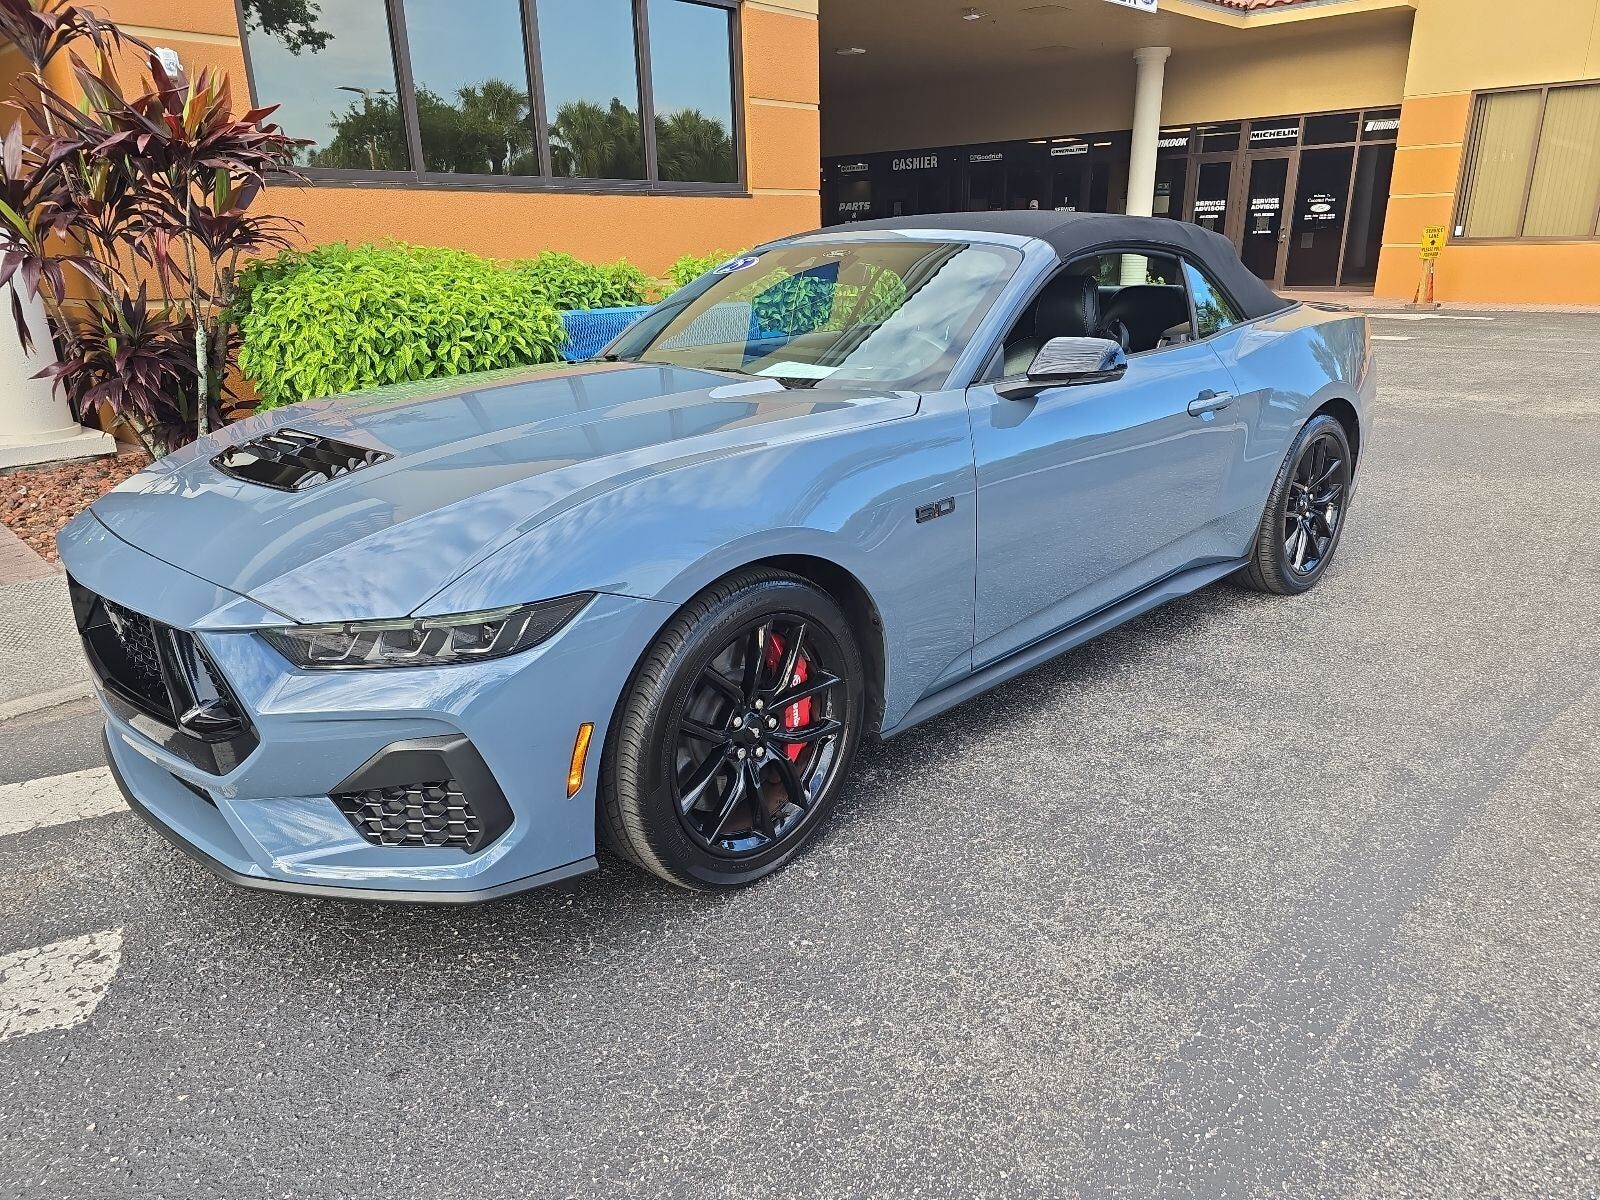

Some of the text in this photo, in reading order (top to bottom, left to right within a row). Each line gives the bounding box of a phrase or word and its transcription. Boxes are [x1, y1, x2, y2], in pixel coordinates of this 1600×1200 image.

[1251, 129, 1298, 139] MICHELIN
[1158, 137, 1189, 148] NKOOK
[892, 155, 939, 171] CASHIER
[839, 201, 871, 211] PARTS
